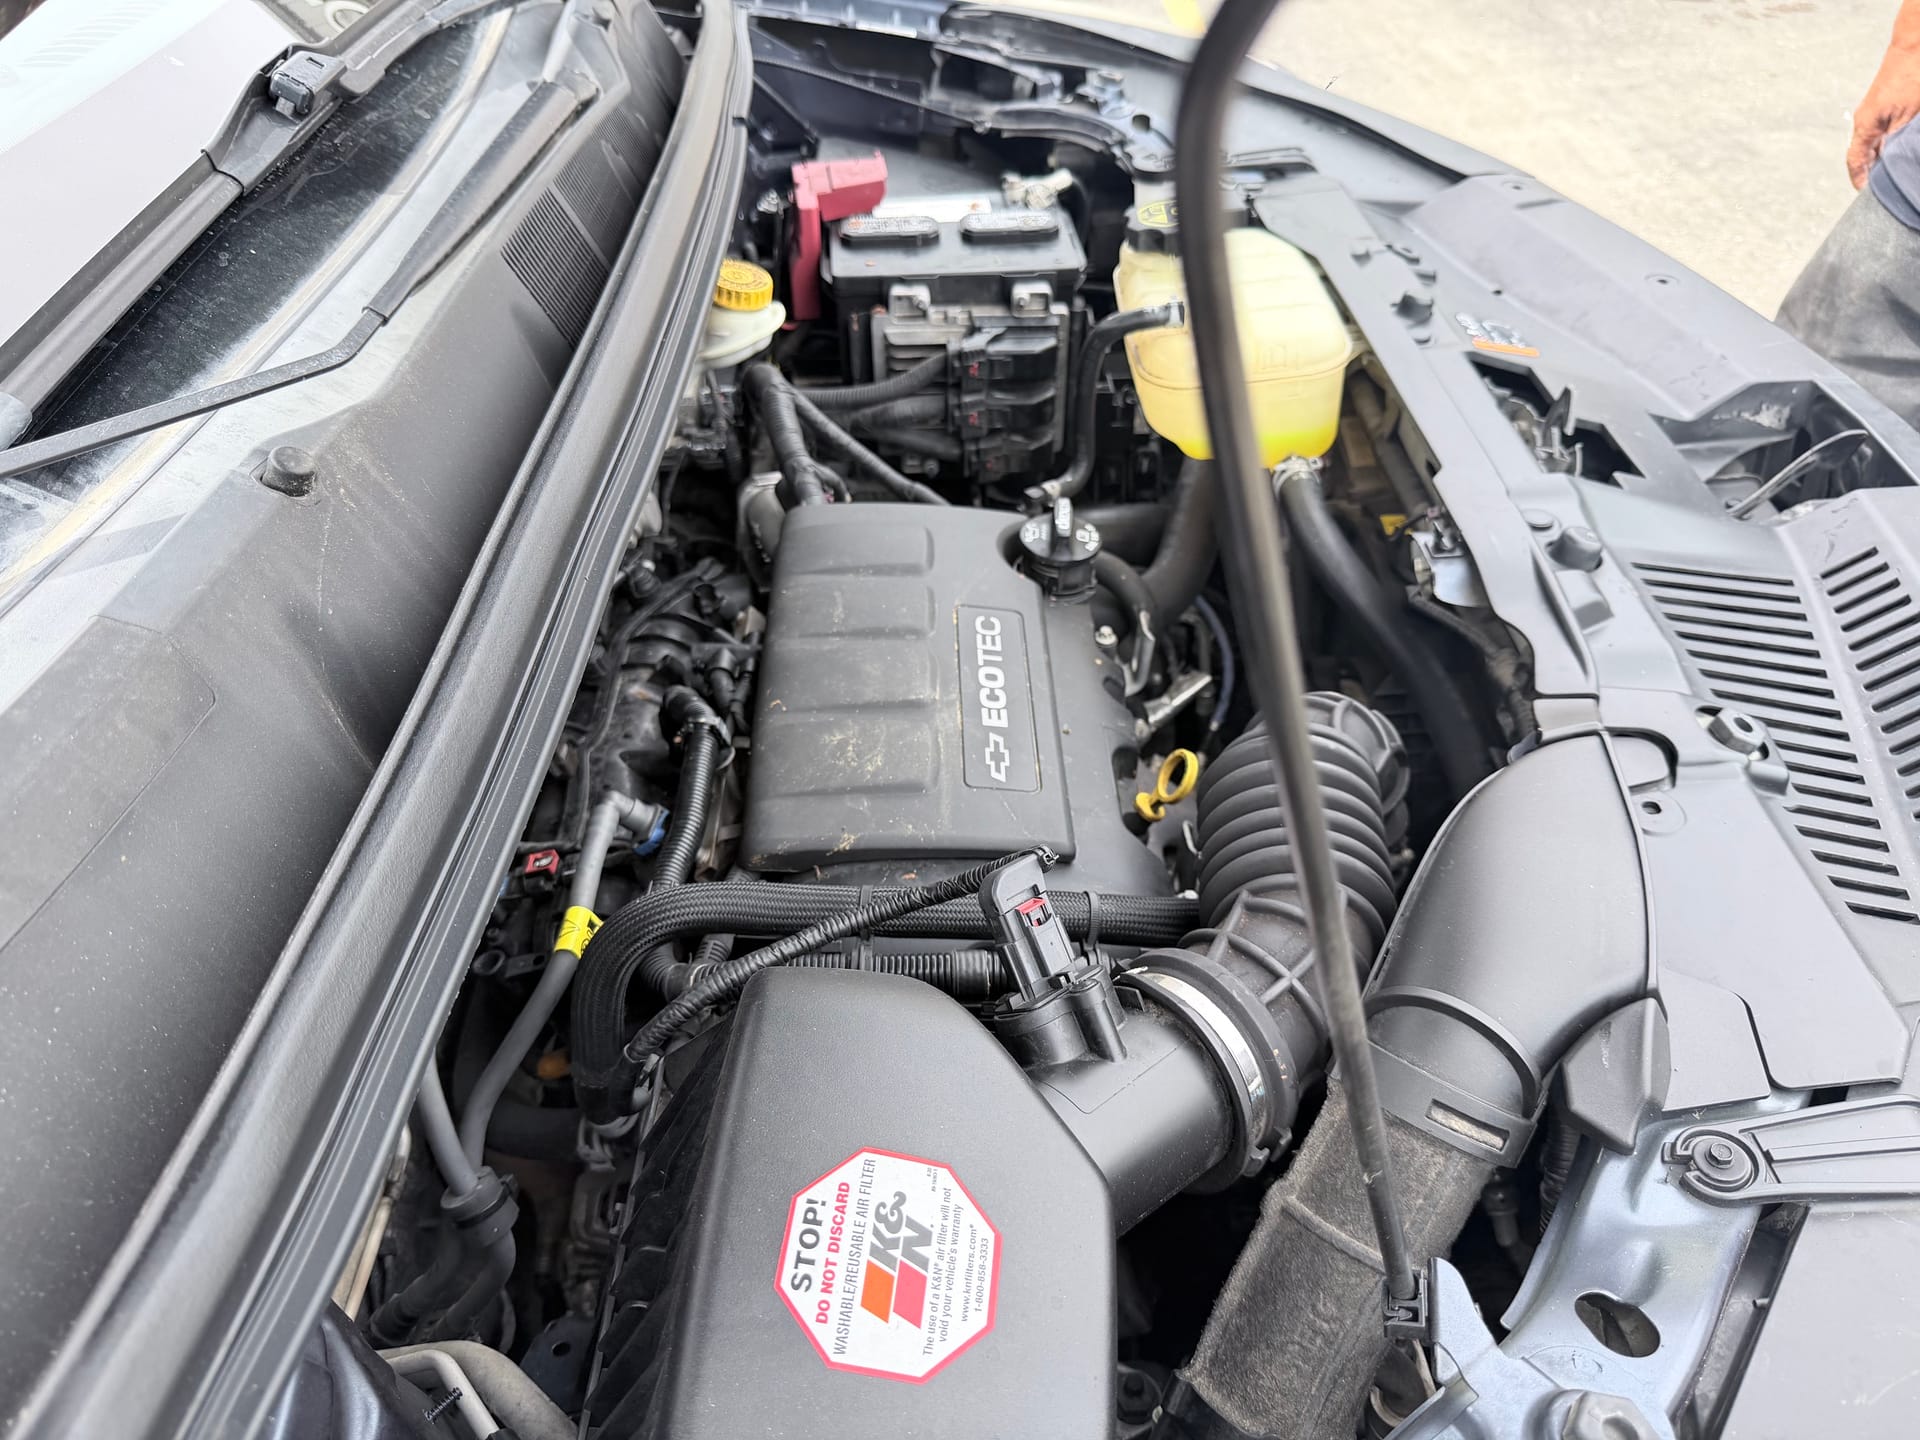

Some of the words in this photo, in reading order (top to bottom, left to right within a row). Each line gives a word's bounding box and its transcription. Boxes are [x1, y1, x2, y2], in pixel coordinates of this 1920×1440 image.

[975, 615, 1009, 728] ECOTEC
[859, 1158, 876, 1195] FILTER
[943, 1187, 952, 1203] not
[827, 1181, 850, 1253] DISCARD
[856, 1198, 871, 1219] AIR
[940, 1204, 950, 1221] will
[936, 1222, 948, 1246] filter
[951, 1203, 965, 1246] warranty
[790, 1198, 827, 1293] STOP!
[936, 1247, 946, 1261] air
[820, 1257, 837, 1294] NOT
[944, 1247, 958, 1291] vehicle's
[833, 1220, 866, 1355] WASHABLE/REUSABLE
[815, 1299, 831, 1325] DO
[929, 1301, 939, 1312] of
[942, 1294, 953, 1318] your
[928, 1314, 938, 1334] use
[939, 1319, 950, 1342] void
[922, 1336, 935, 1355] The
